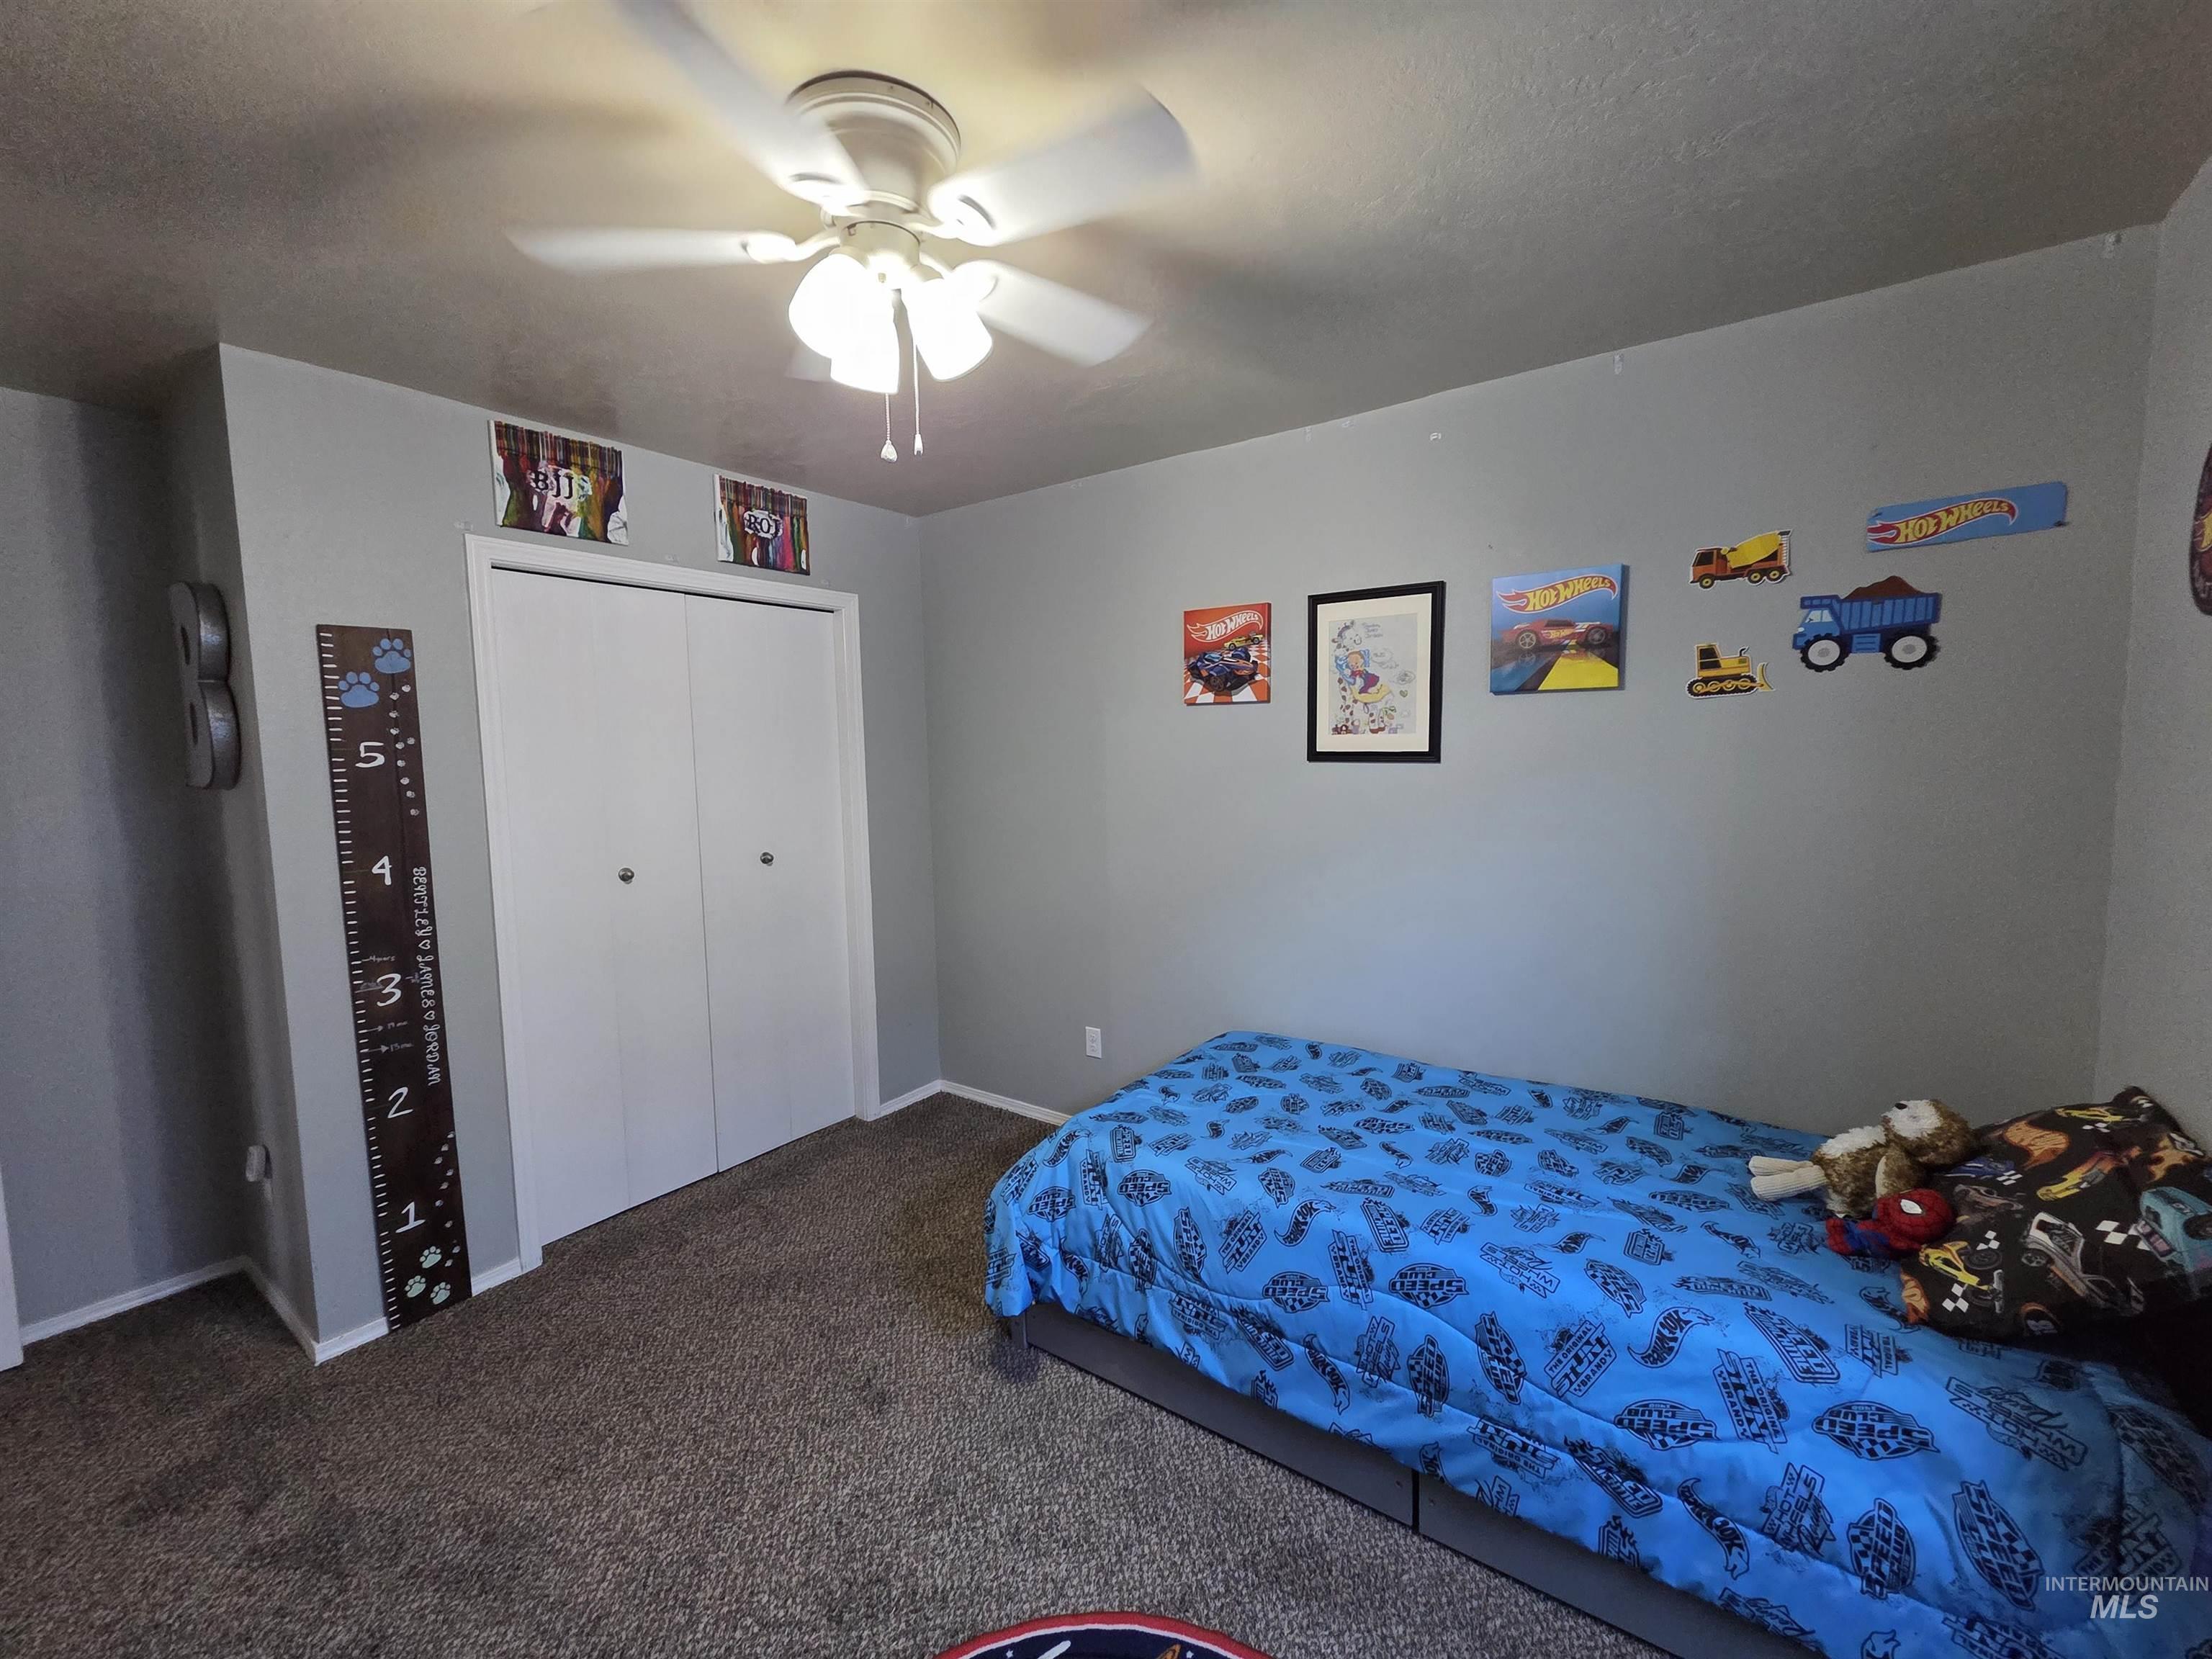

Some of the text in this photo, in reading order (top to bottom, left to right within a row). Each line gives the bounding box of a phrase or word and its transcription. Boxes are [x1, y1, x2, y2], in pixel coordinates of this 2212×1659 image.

[355, 742, 385, 768] 5
[371, 855, 392, 886] 4
[376, 973, 401, 1007] 3
[387, 1086, 413, 1118] 2
[1119, 1183, 1168, 1192] SPEED
[395, 1201, 426, 1233] 1
[1264, 1287, 1327, 1298] SPEED
[1393, 1280, 1464, 1290] SPEED
[1547, 1331, 1610, 1394] STUNT
[1548, 1325, 1593, 1374] THE ORIGINAL
[1578, 1355, 1609, 1387] BRAND
[1745, 1362, 1760, 1387] THE
[1625, 1407, 1677, 1420] CLUB
[1721, 1380, 1745, 1429] BRAND
[1828, 1409, 1884, 1423] CLUB
[1614, 1416, 1715, 1439] SPEED
[1814, 1417, 1931, 1447] SPEED
[1776, 1487, 1795, 1525] HOT
[1781, 1473, 1819, 1547] WHEELS
